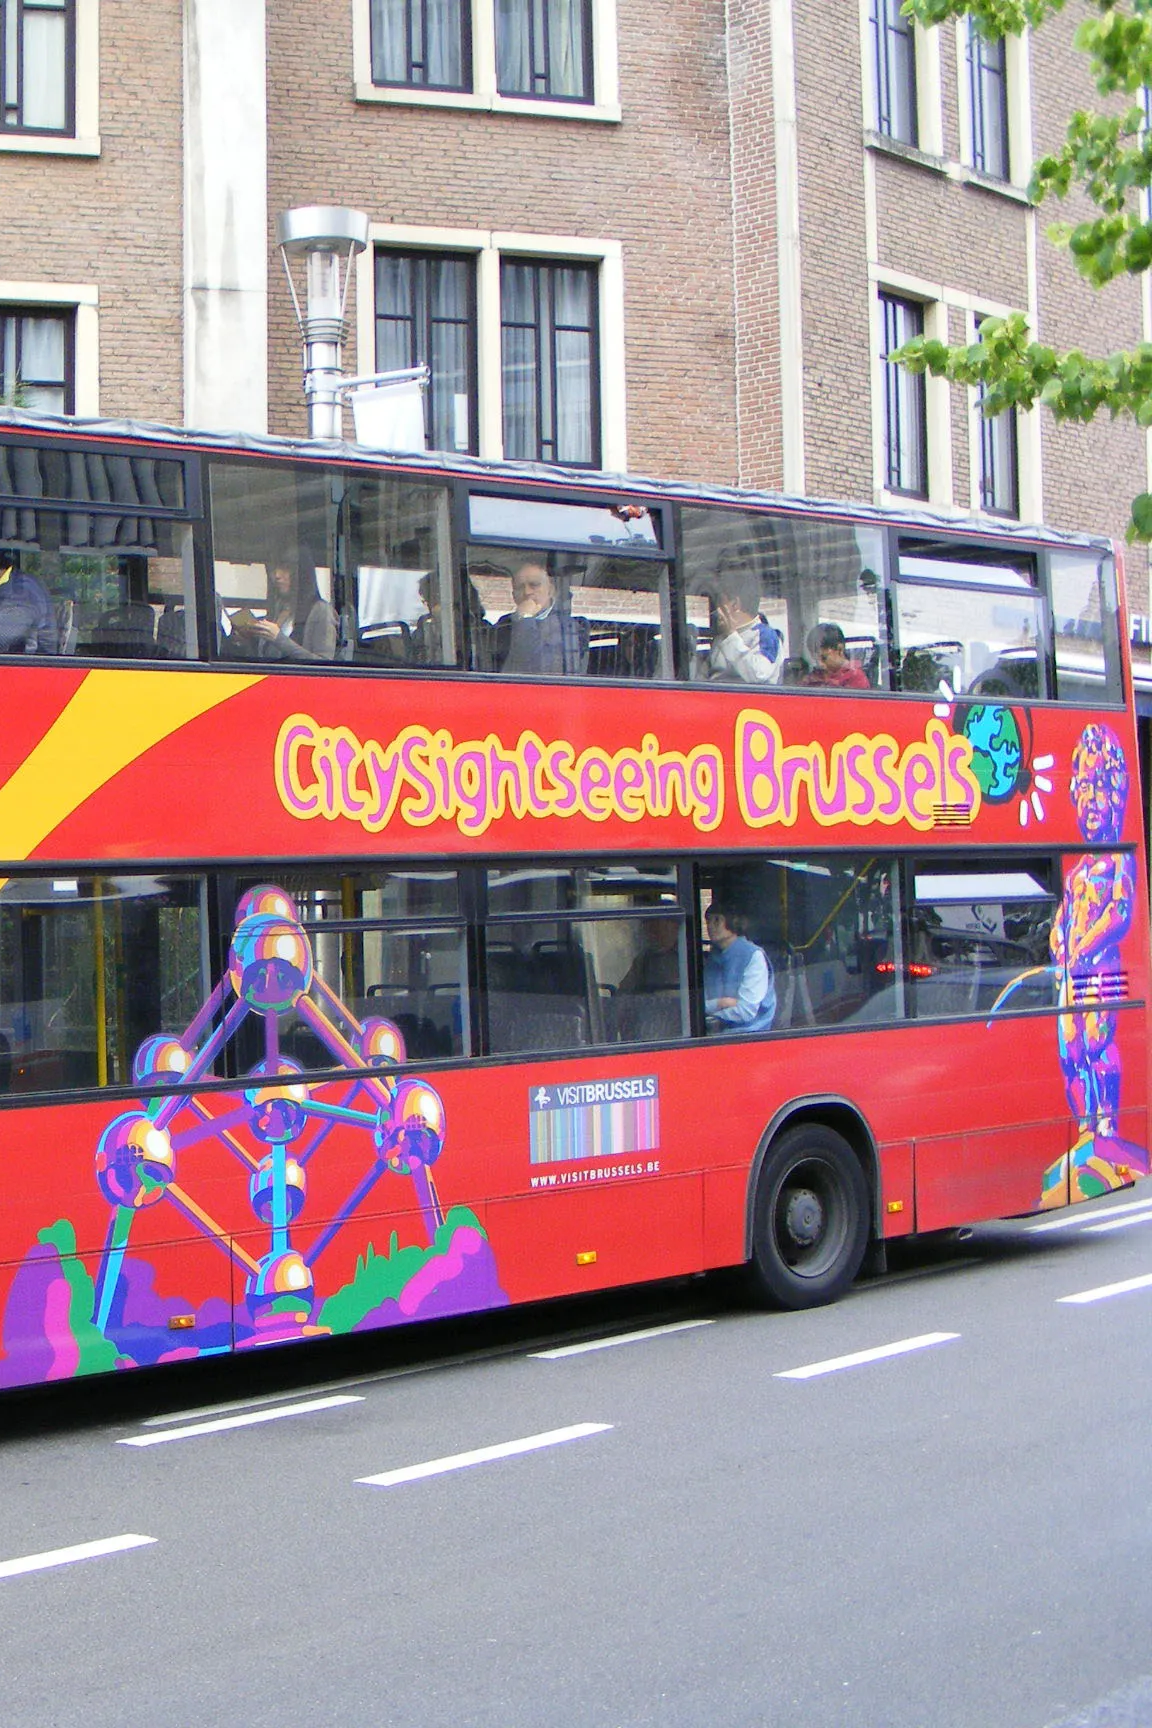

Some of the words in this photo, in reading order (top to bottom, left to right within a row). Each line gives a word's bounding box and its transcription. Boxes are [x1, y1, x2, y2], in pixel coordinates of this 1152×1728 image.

[1129, 613, 1152, 645] FI
[734, 708, 982, 831] Brussels
[556, 1078, 655, 1105] VISITBRUSSELS
[530, 1160, 660, 1188] WWW.VISITBRUSSELS.BE
